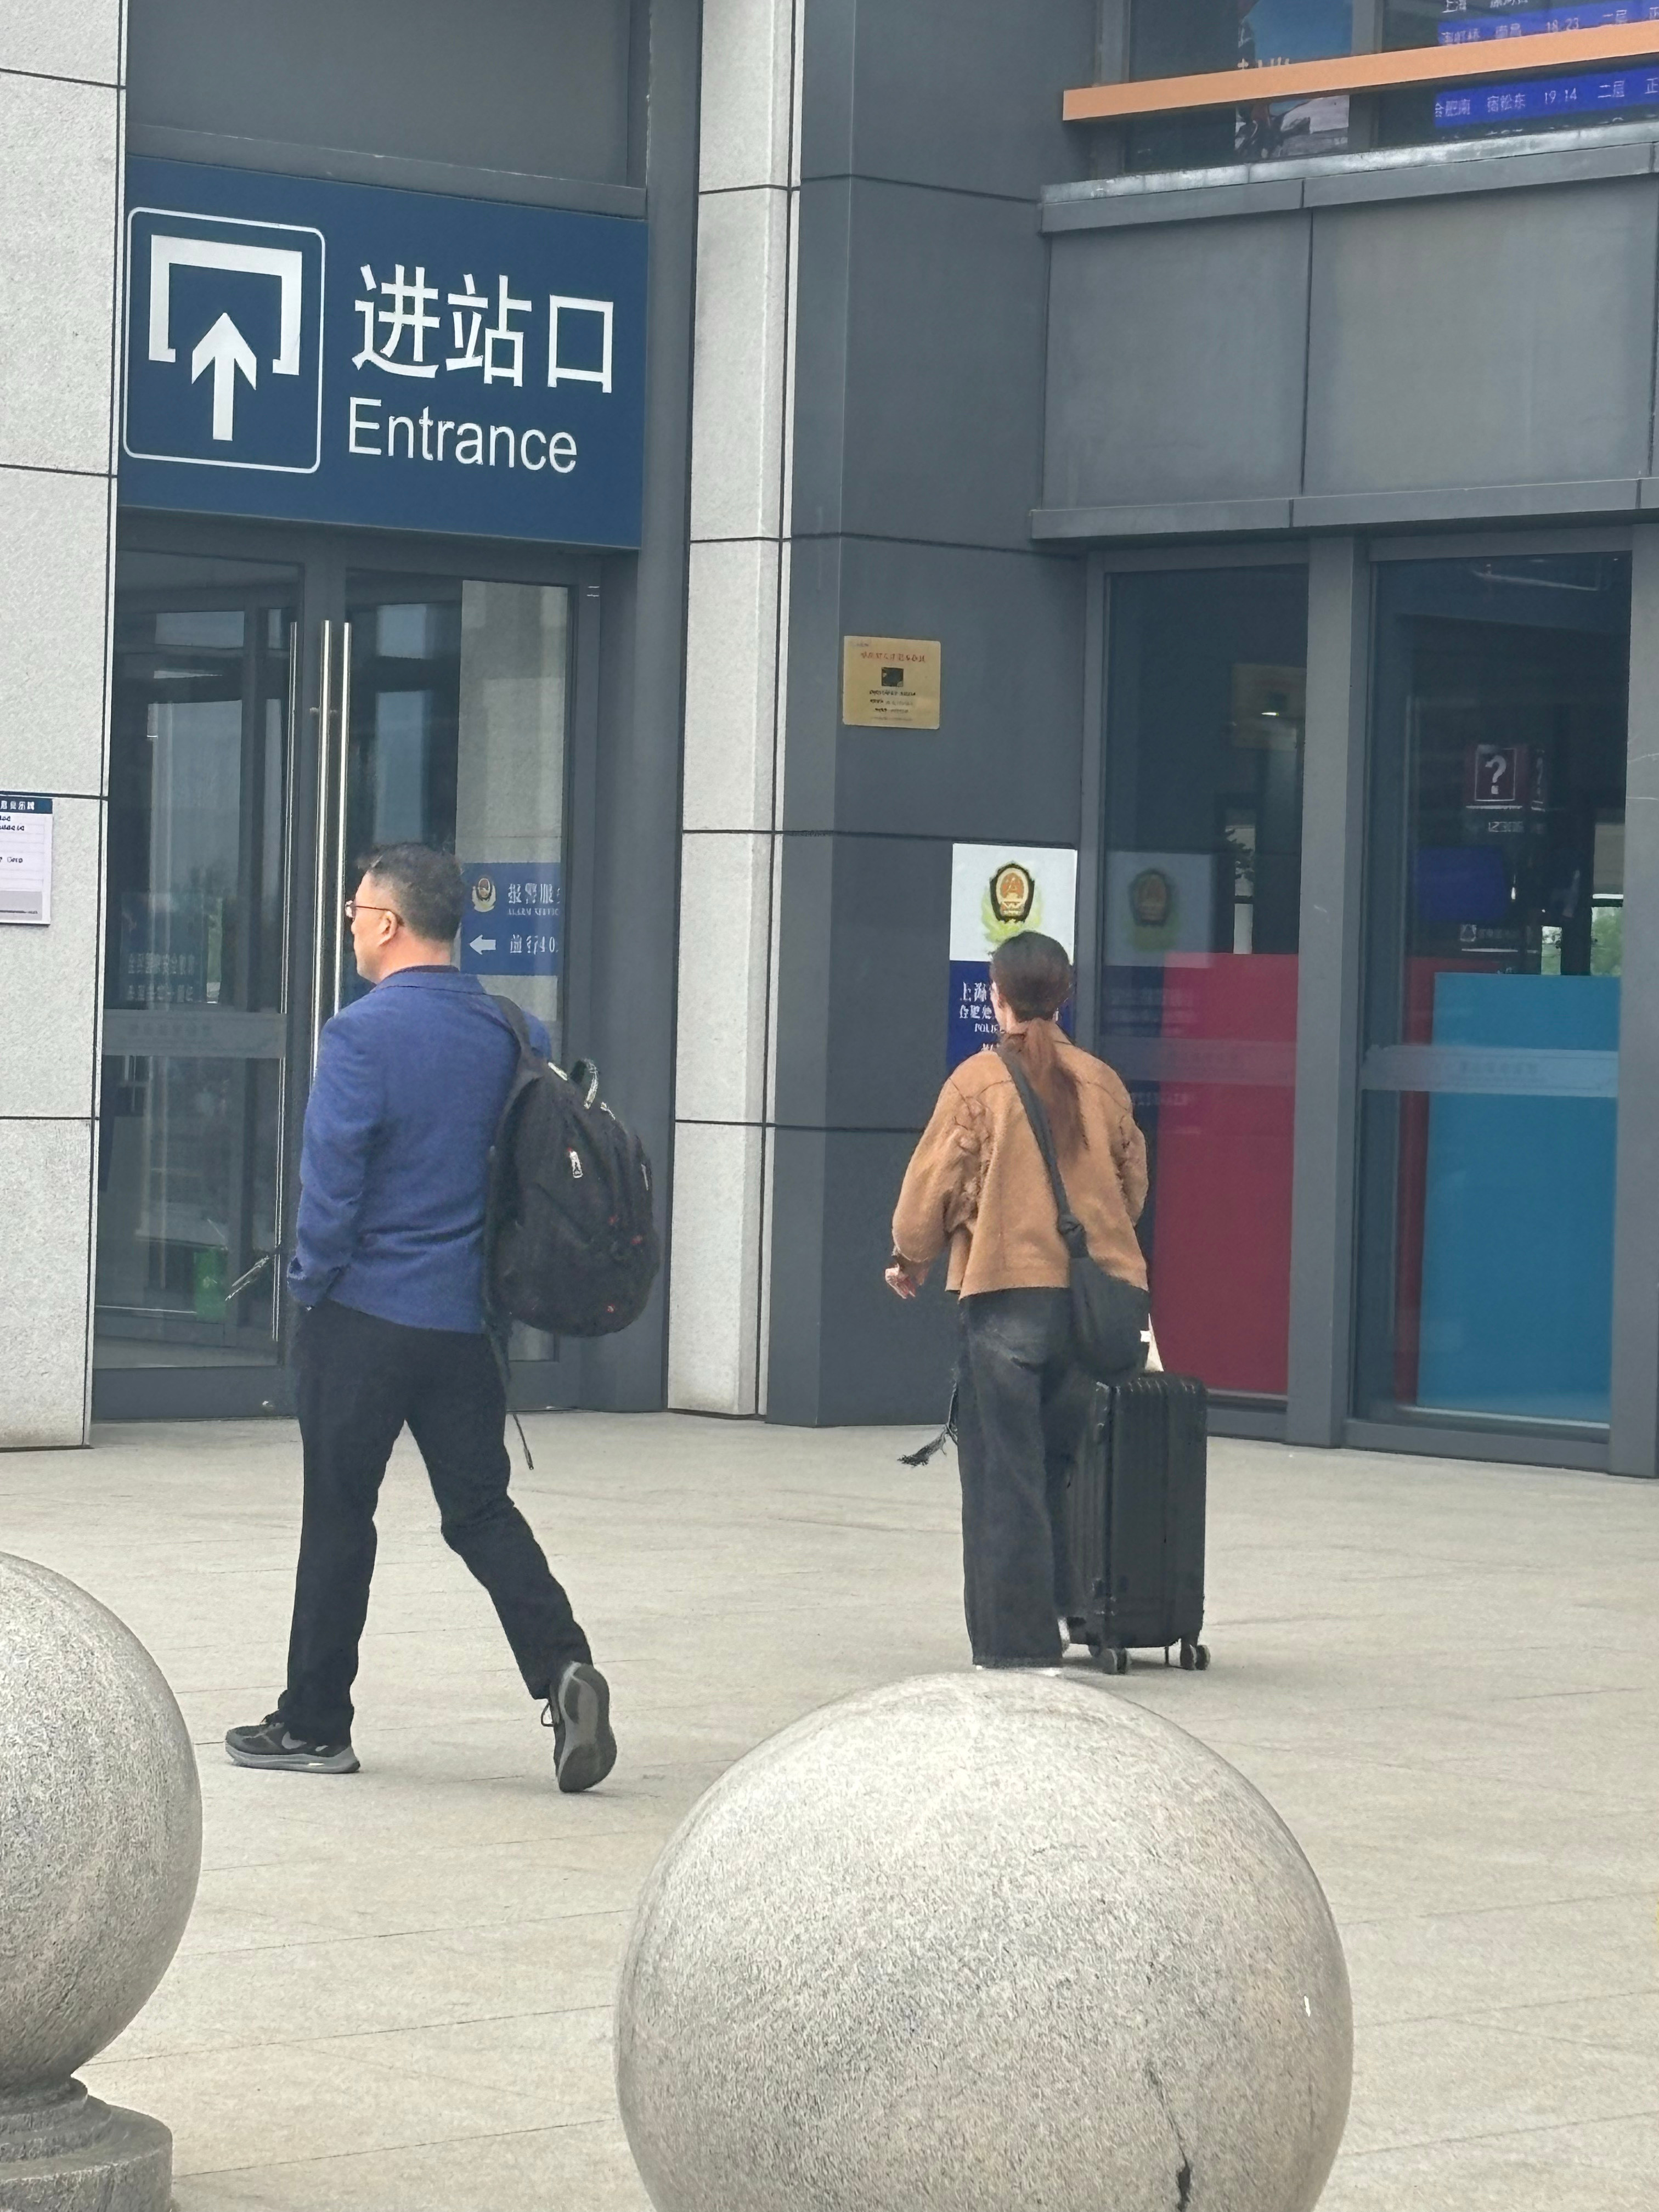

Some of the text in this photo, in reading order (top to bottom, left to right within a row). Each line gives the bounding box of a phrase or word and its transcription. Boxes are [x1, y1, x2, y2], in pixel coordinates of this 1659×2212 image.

[351, 263, 614, 394] 进站口
[349, 397, 577, 474] Entrance
